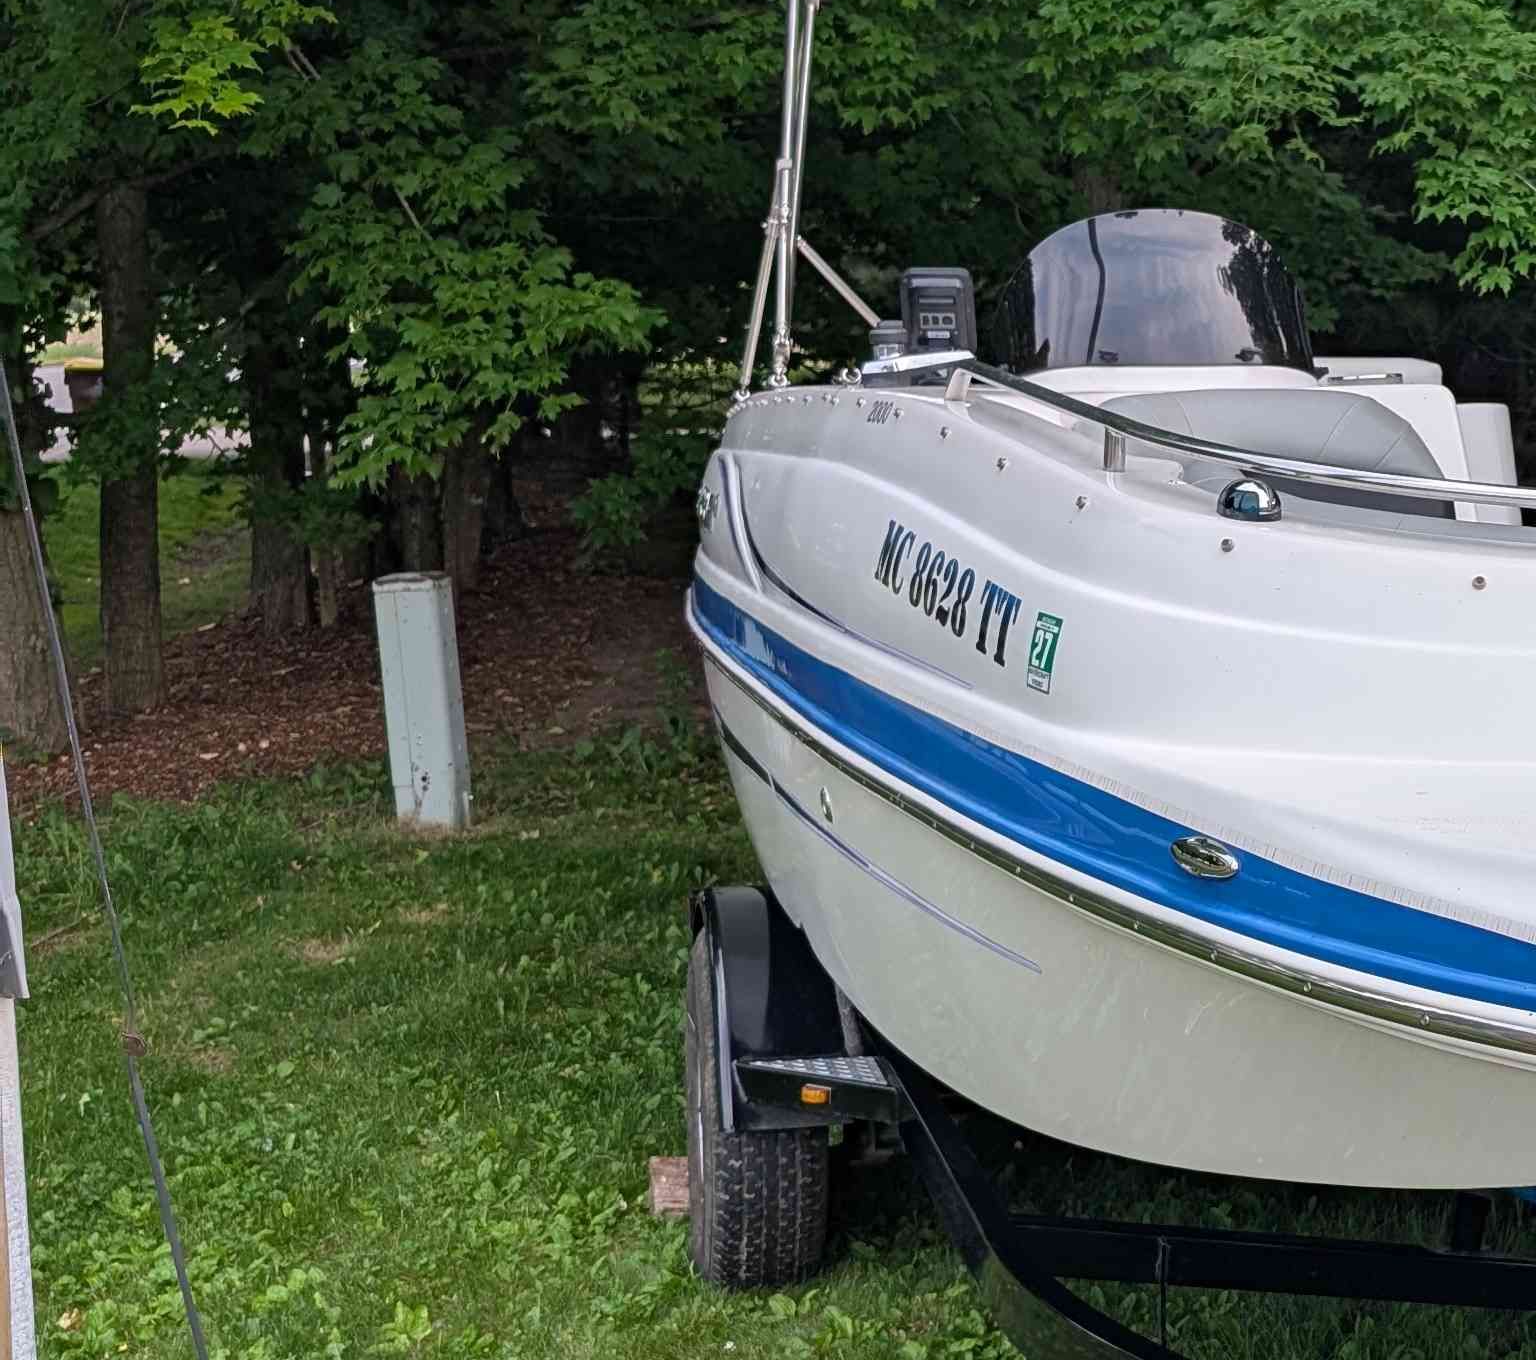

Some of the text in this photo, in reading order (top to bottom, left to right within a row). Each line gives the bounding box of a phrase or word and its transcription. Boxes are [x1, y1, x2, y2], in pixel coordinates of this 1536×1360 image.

[909, 542, 976, 638] 8628
[975, 579, 1023, 668] TT
[1031, 629, 1054, 669] 27
